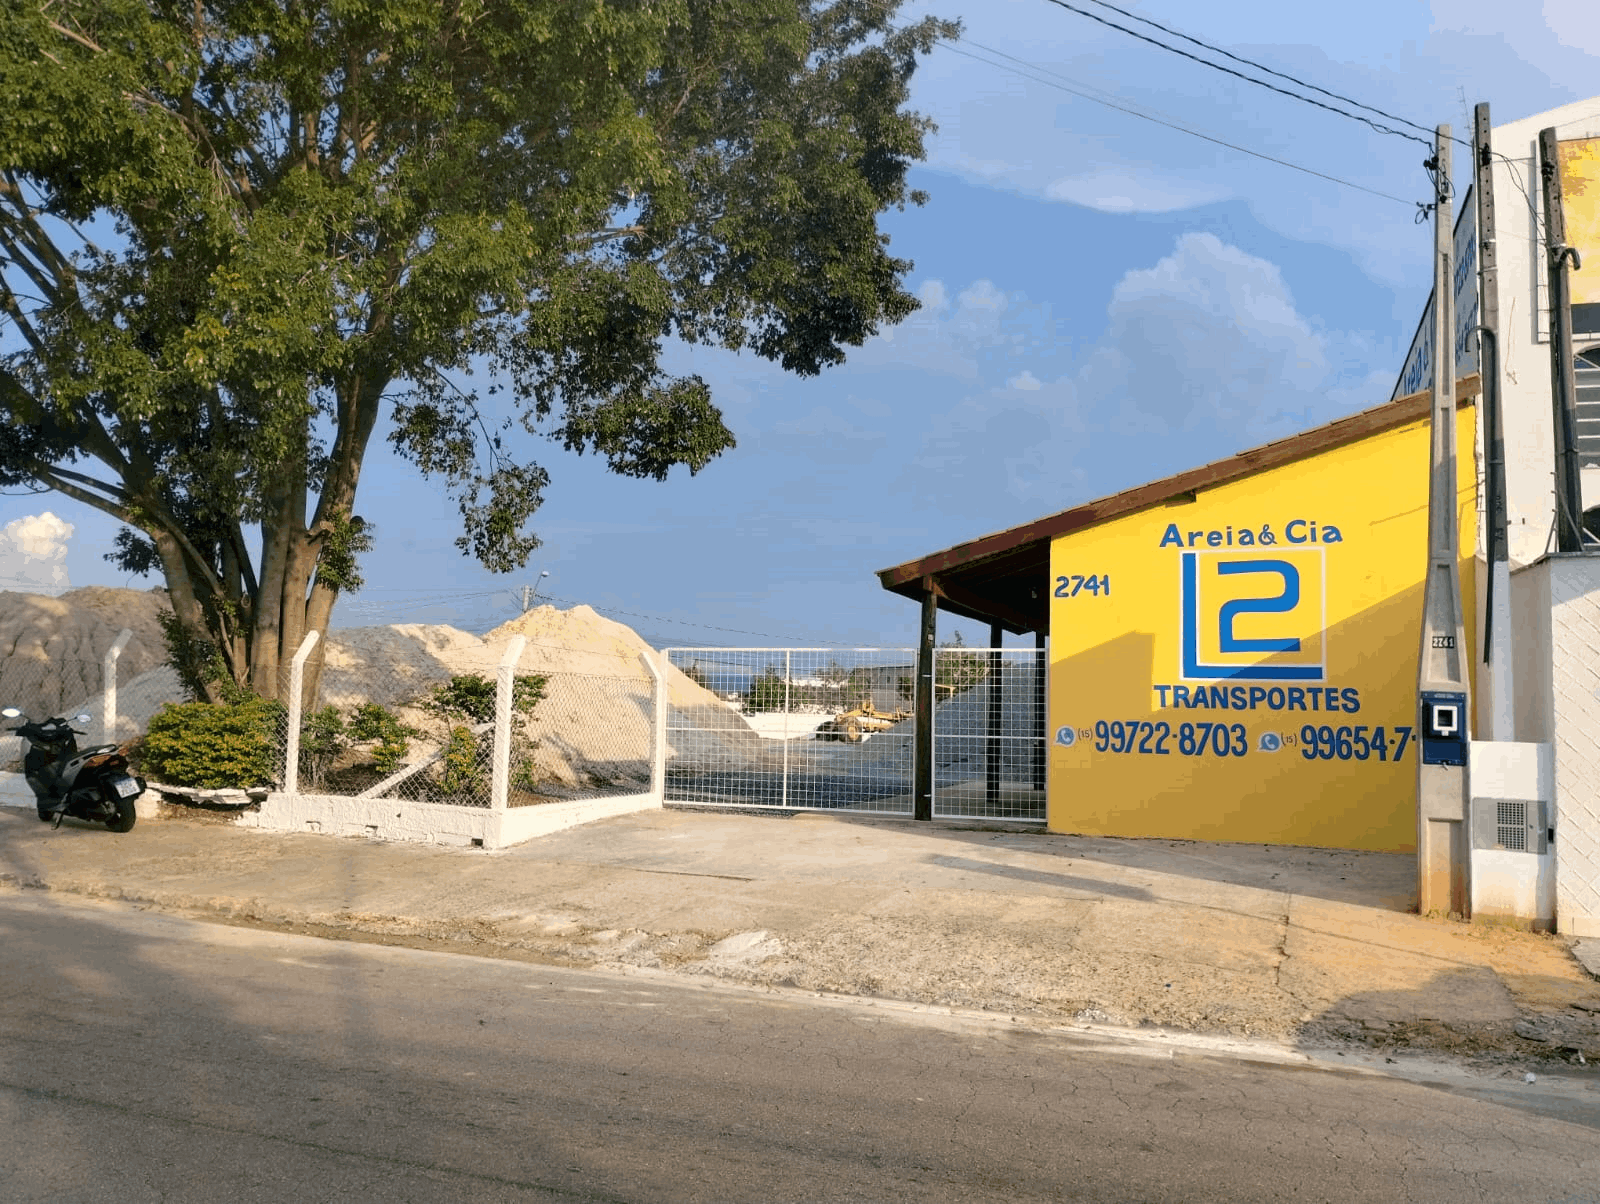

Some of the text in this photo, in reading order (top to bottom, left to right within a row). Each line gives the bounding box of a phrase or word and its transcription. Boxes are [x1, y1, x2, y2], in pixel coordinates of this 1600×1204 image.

[1285, 519, 1343, 544] Cia
[1054, 575, 1110, 598] 2741
[1153, 685, 1361, 714] TRANSPORTES
[1077, 728, 1093, 741] (15)
[1281, 733, 1298, 747] (15)
